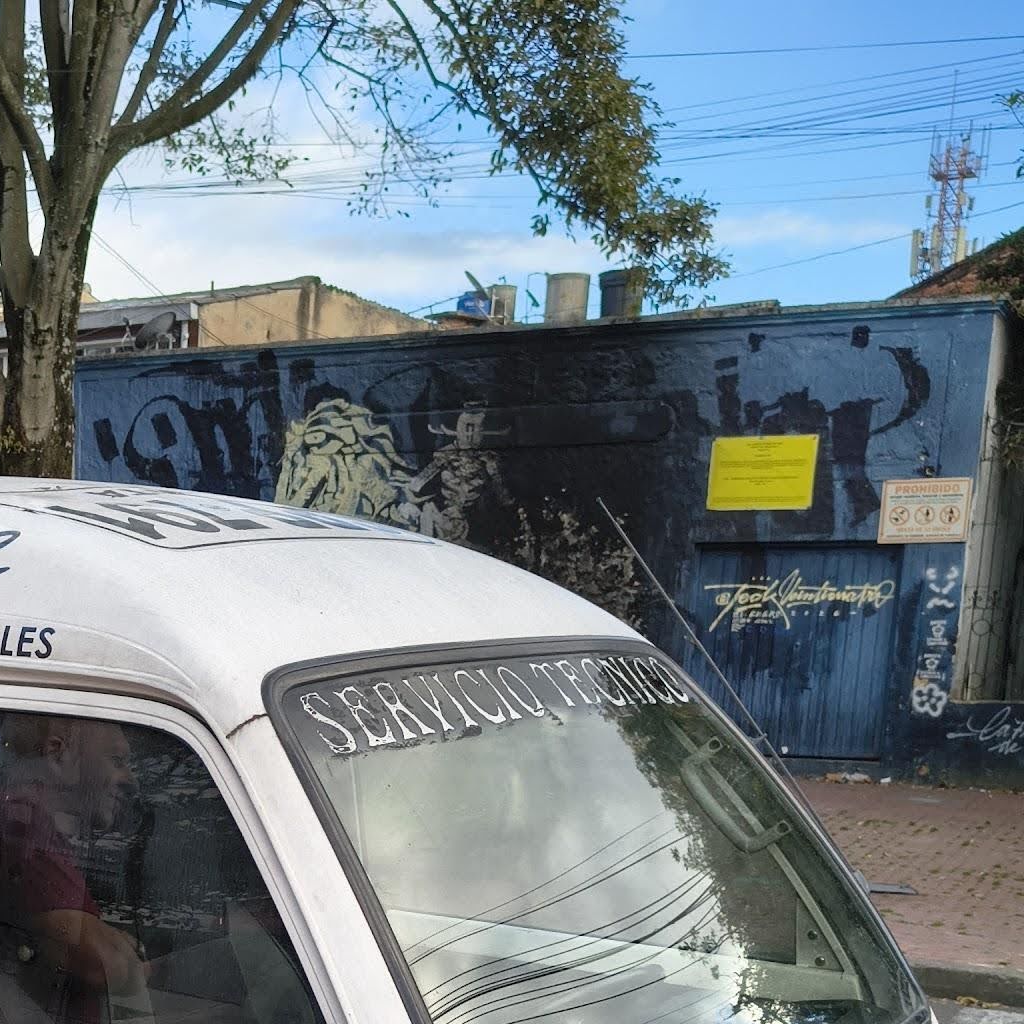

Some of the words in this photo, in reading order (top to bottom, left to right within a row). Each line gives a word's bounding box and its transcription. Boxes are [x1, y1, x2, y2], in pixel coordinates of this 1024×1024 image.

[895, 484, 961, 494] PROHIBIDO
[300, 669, 546, 755] SERVICIO
[528, 656, 690, 707] TECNICO
